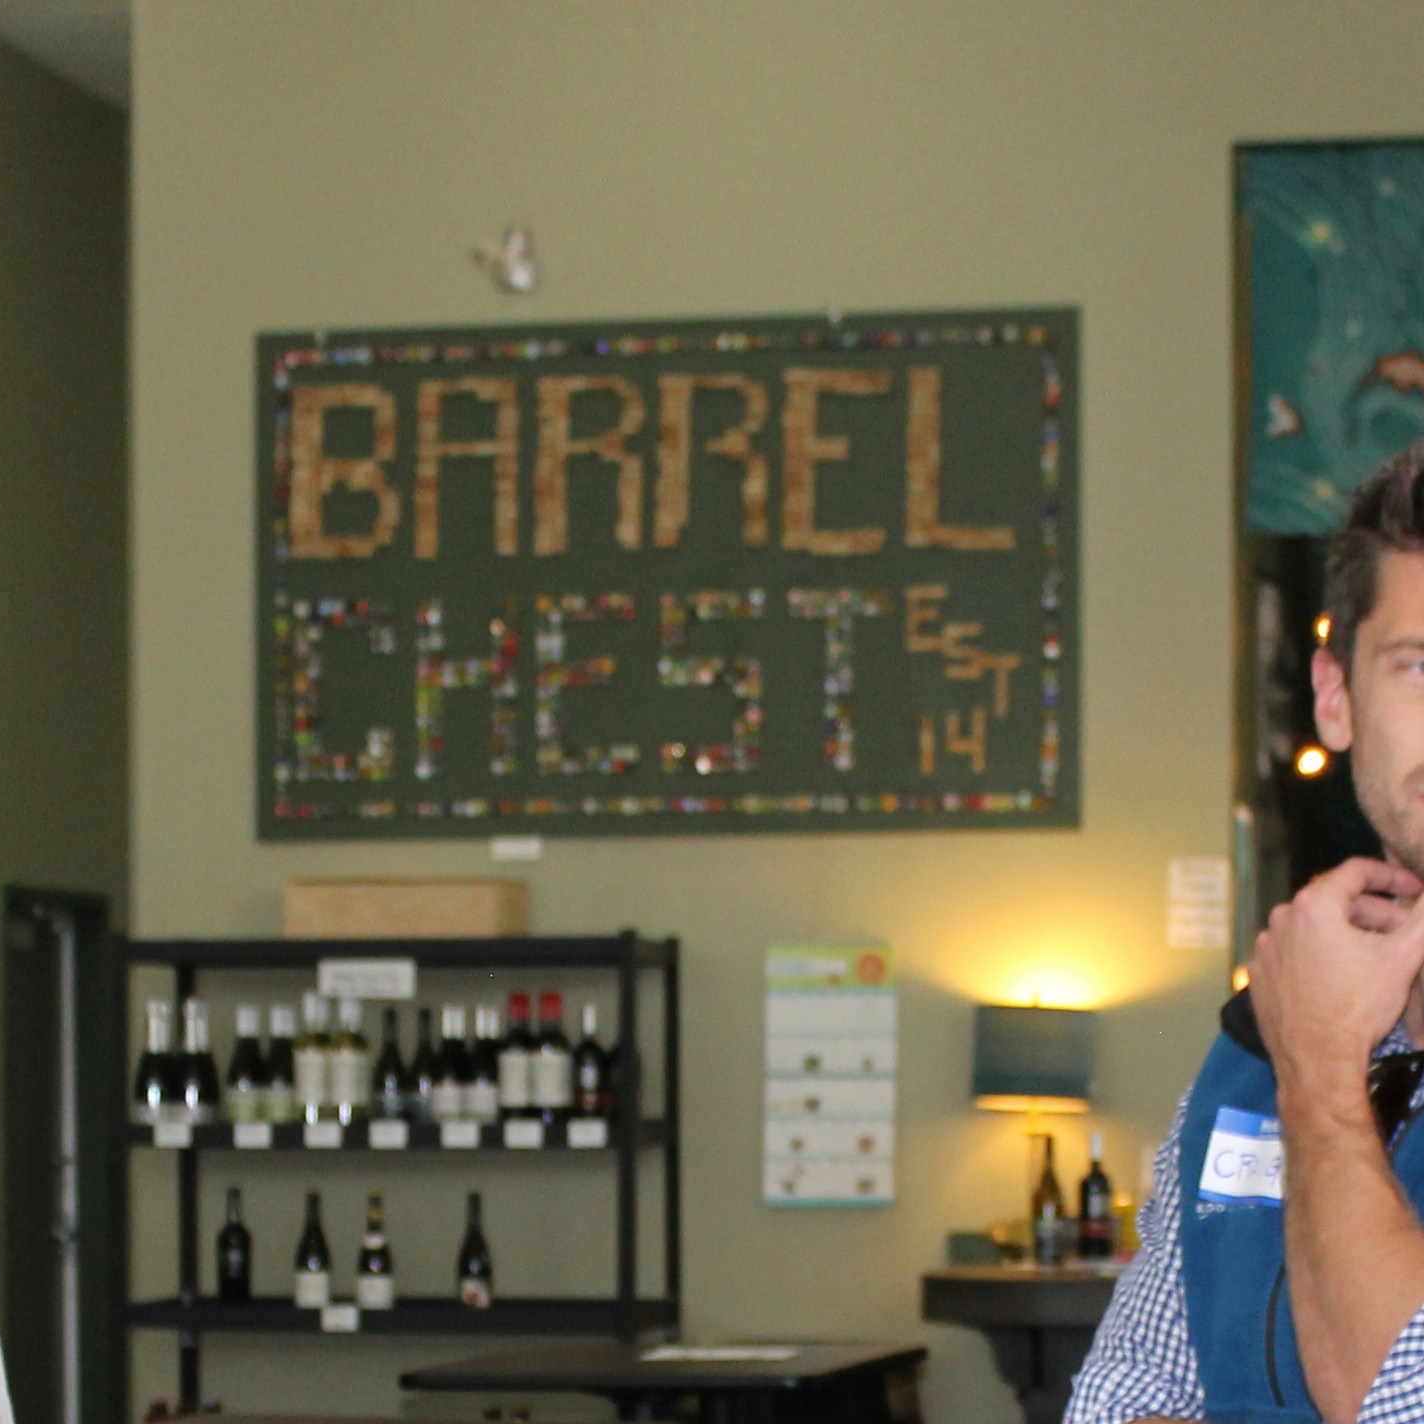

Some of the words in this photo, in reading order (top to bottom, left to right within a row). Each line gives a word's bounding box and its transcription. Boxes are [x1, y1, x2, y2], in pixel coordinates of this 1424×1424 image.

[290, 366, 1016, 560] BARREL
[295, 587, 892, 781] CHEST
[921, 707, 988, 776] 14
